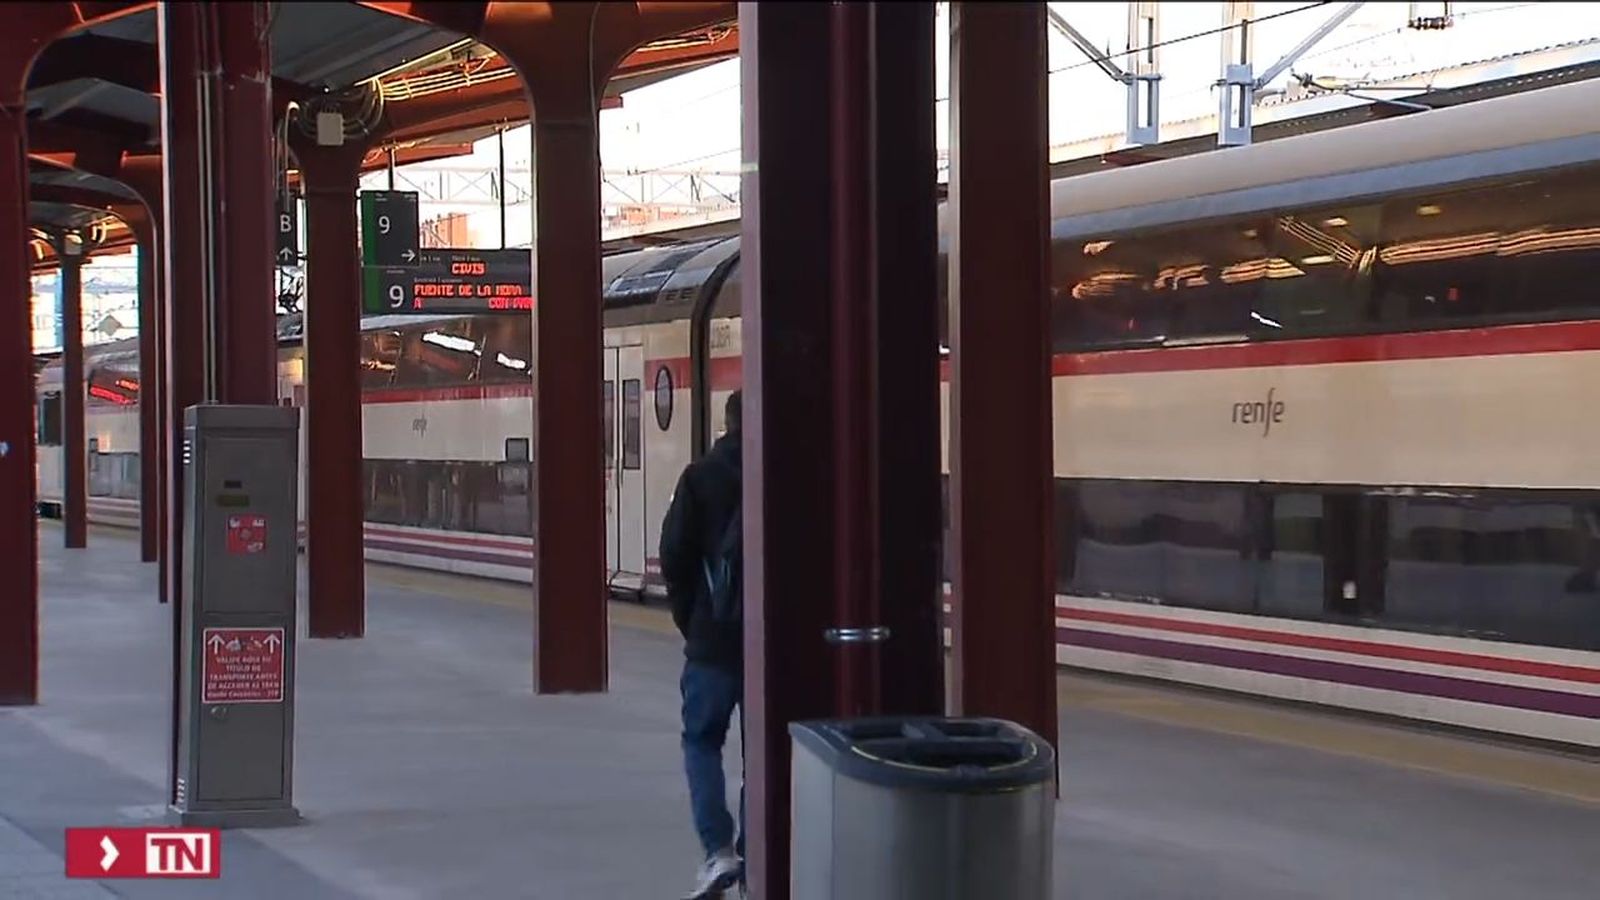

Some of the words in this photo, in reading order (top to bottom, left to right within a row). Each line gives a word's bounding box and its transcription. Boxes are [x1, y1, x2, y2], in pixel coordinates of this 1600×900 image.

[280, 214, 292, 232] B
[379, 215, 390, 234] 9
[451, 262, 485, 275] CIVIS
[389, 285, 404, 308] 9
[414, 284, 454, 296] FUENTE
[458, 284, 473, 296] DE
[477, 284, 492, 296] LA
[1231, 387, 1285, 438] renfe
